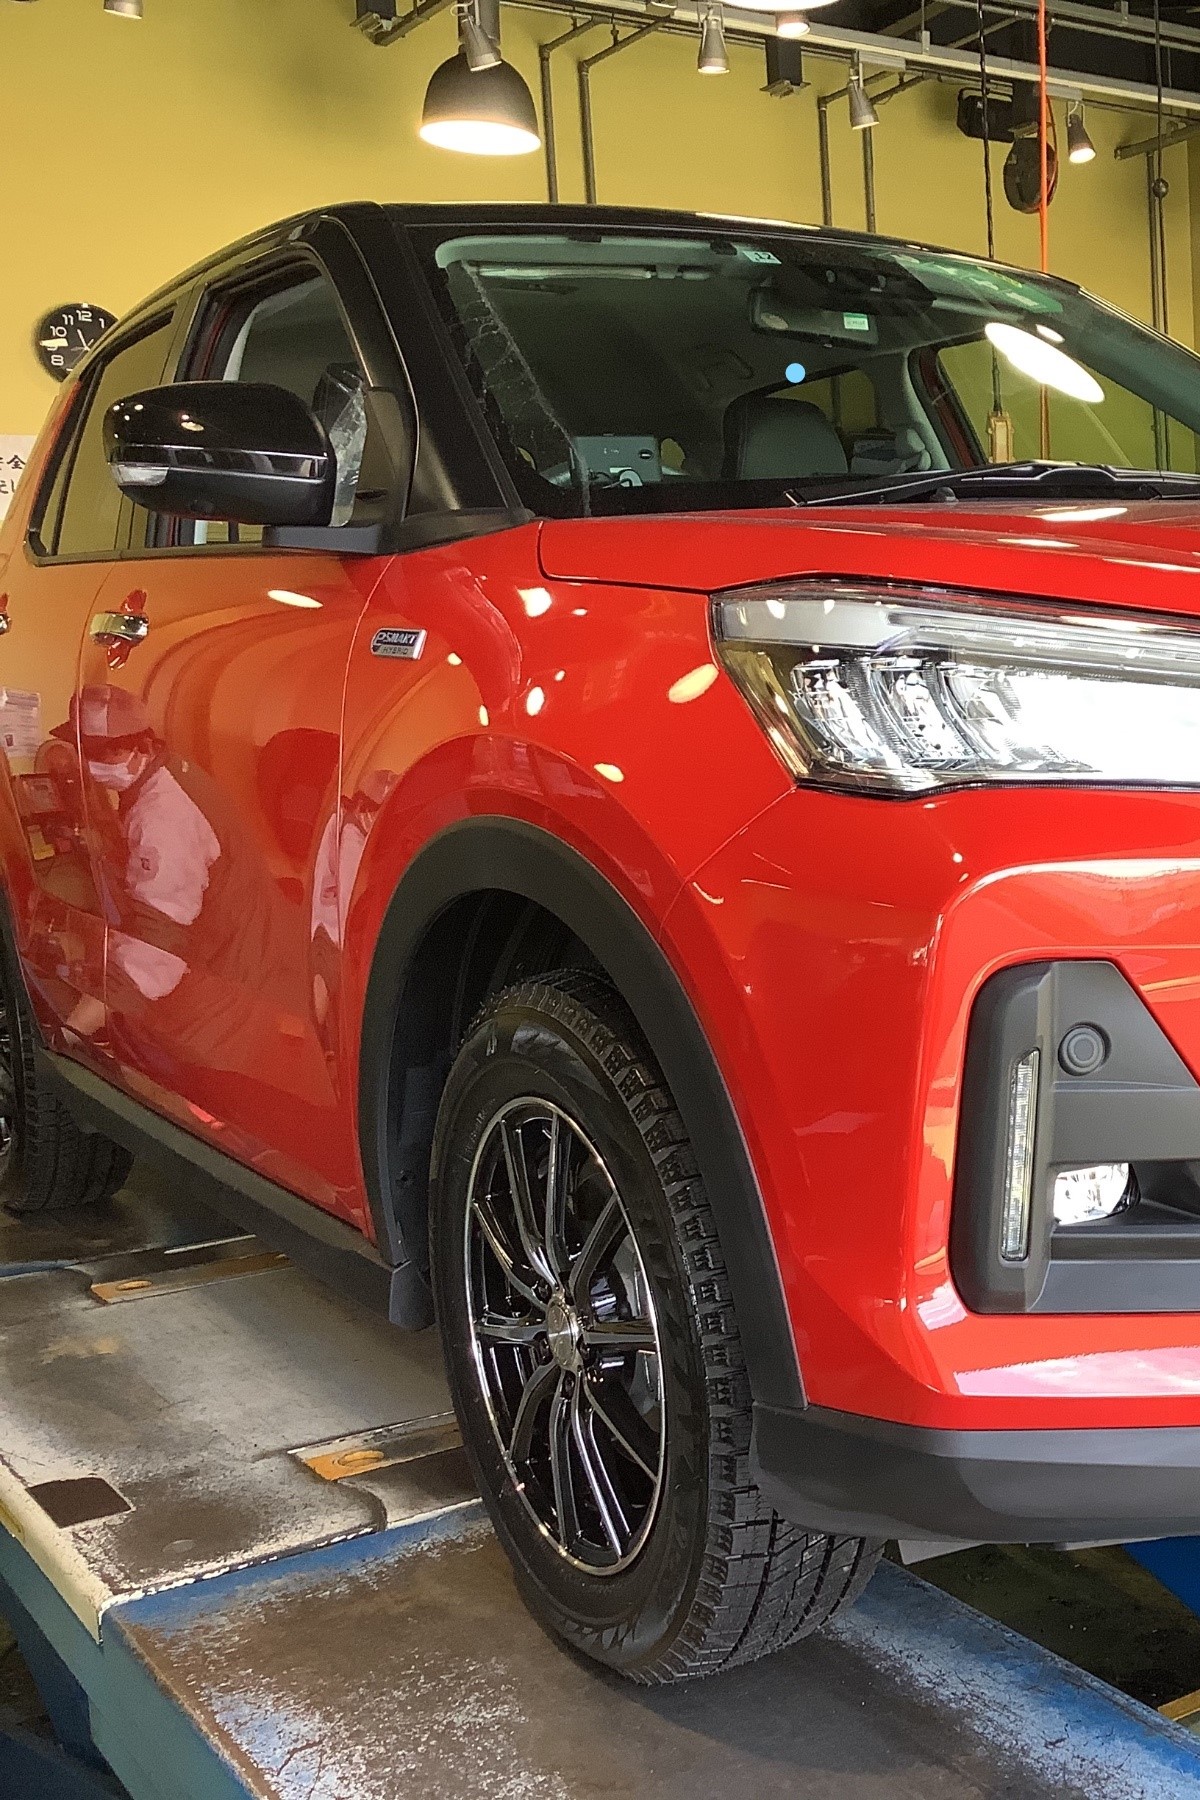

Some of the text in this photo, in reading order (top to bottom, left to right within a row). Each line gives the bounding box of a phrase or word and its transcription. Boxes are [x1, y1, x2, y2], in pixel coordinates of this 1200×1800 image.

[61, 313, 74, 326] 11
[75, 309, 92, 322] 12
[98, 317, 105, 329] 1
[50, 325, 67, 337] 10
[50, 354, 64, 366] 8
